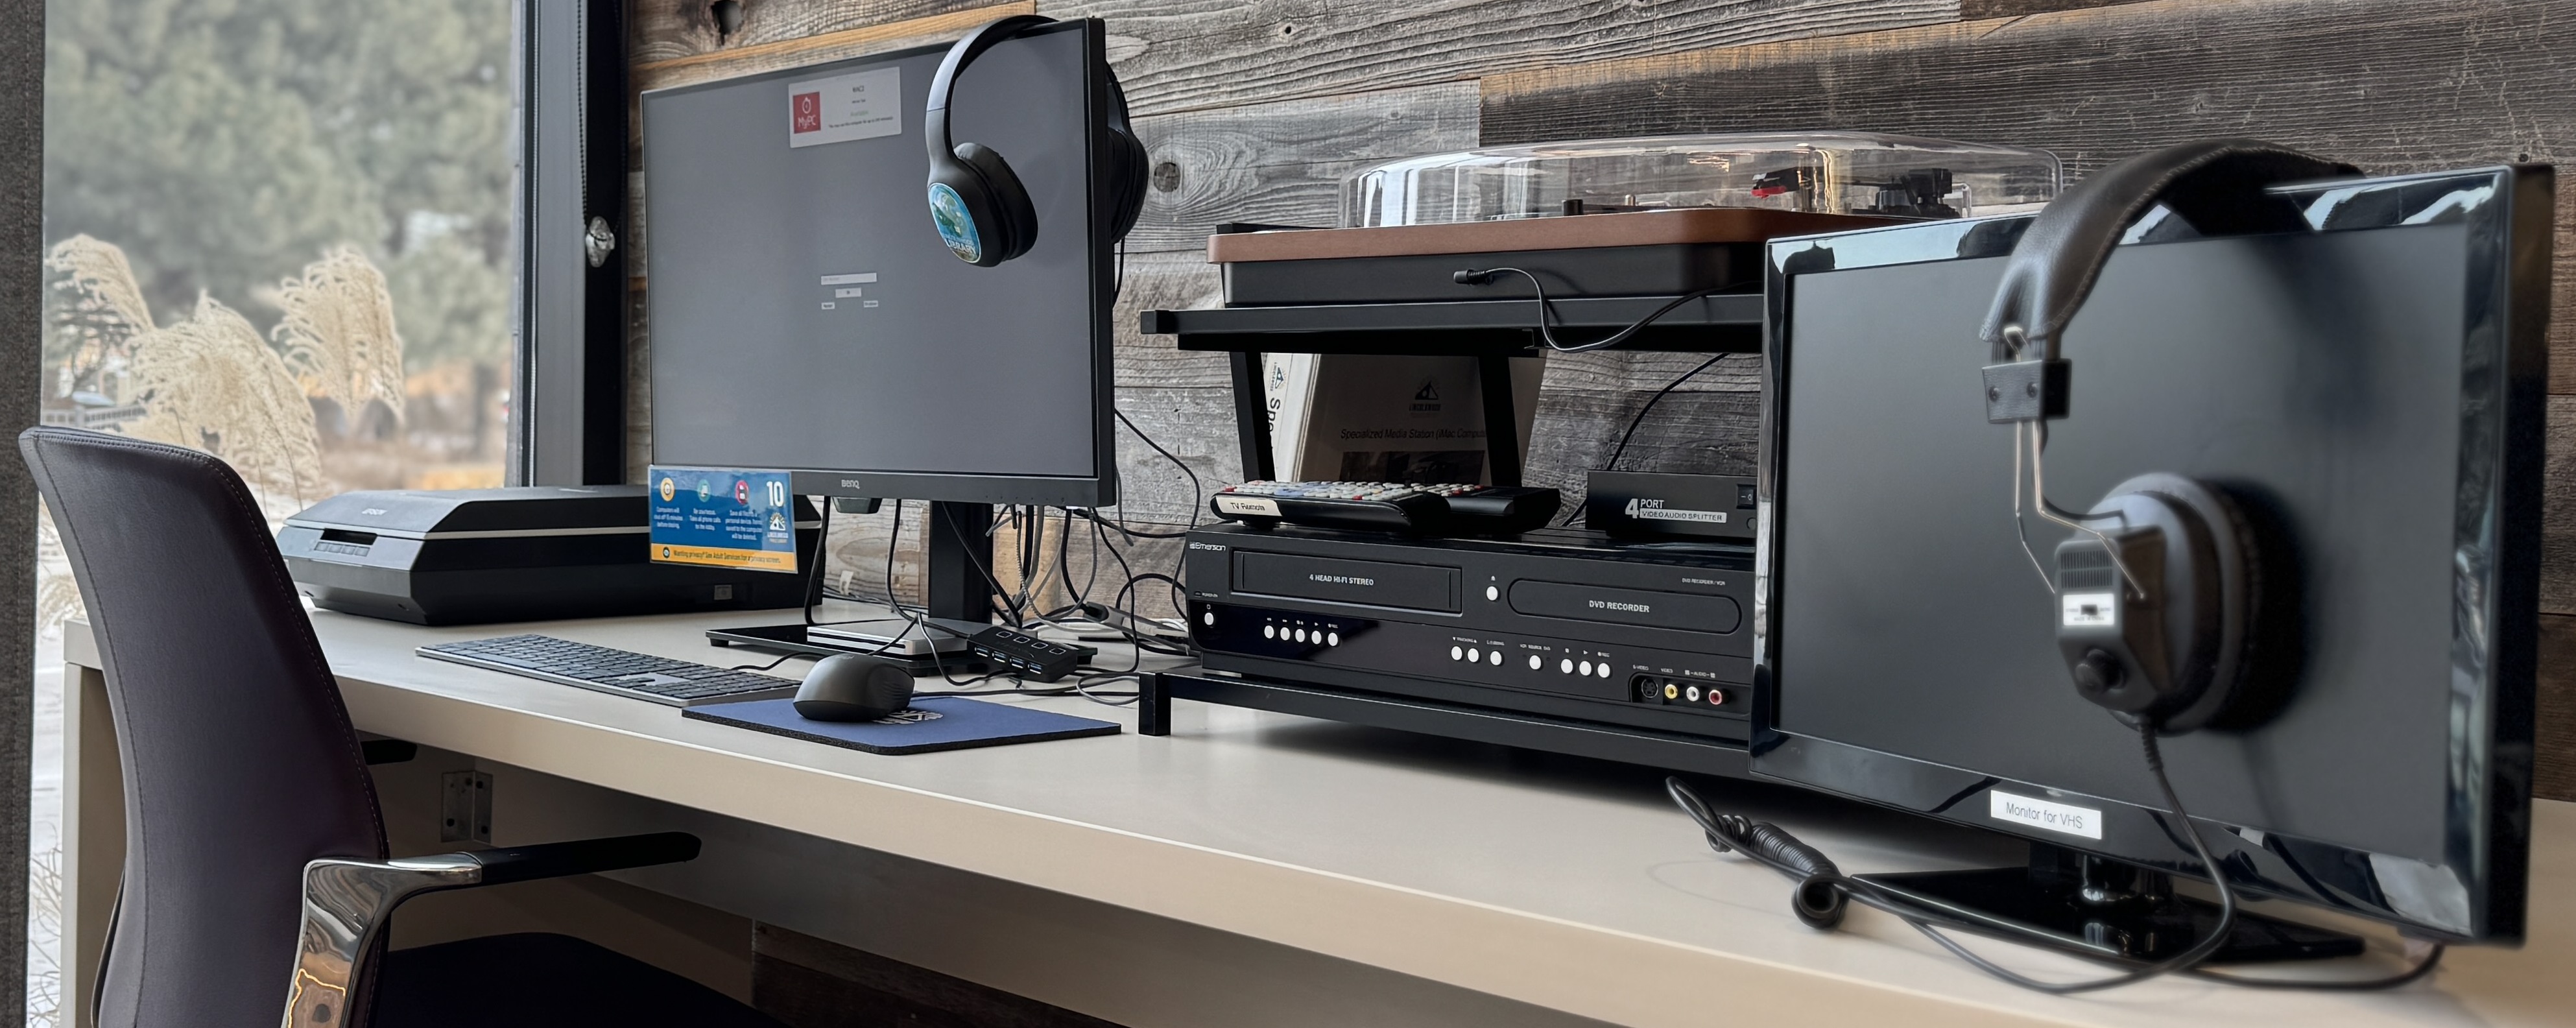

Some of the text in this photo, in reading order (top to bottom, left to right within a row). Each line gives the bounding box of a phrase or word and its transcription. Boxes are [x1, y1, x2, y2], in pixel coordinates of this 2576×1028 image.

[798, 114, 817, 129] MyPC
[1341, 428, 1383, 440] Specialized
[1384, 429, 1407, 438] Media
[1409, 429, 1434, 438] Station
[766, 481, 785, 507] 10
[1241, 503, 1265, 511] Remote
[1625, 498, 1665, 519] 4 PORT
[1195, 541, 1226, 551] Emerson
[1349, 577, 1374, 586] STEREO
[1589, 600, 1650, 613] DVD RECORDER
[2006, 802, 2083, 829] Monitor for VHS
